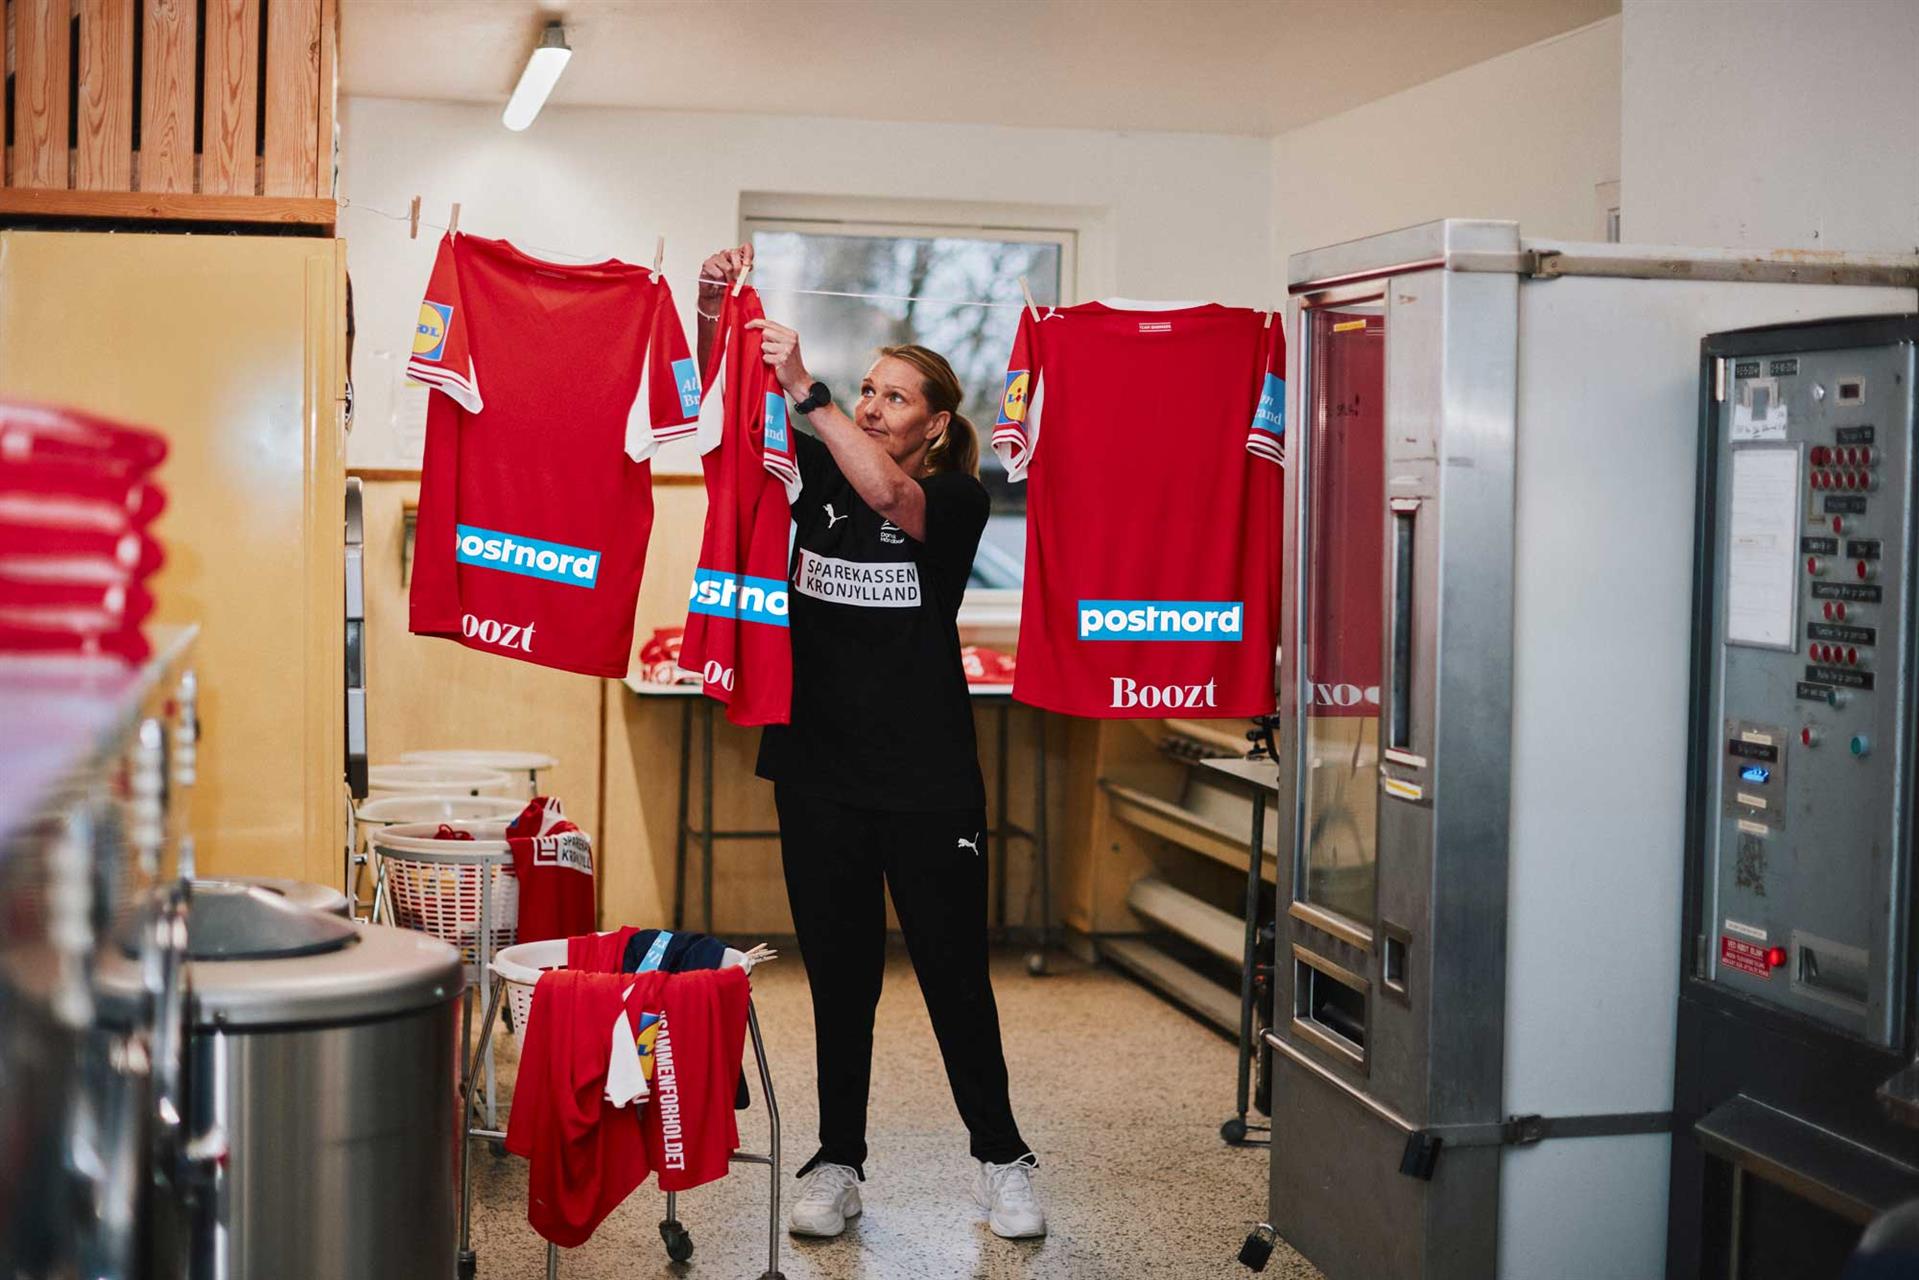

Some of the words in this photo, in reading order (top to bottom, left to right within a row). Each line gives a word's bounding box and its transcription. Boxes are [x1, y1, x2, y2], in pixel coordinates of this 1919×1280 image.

[456, 533, 597, 579] ostnord
[807, 559, 916, 583] SPAREKASSEN
[807, 576, 918, 600] KRONJYLLAND
[462, 613, 536, 653] oozt
[1080, 606, 1240, 637] postnord
[1110, 676, 1218, 708] Boozt
